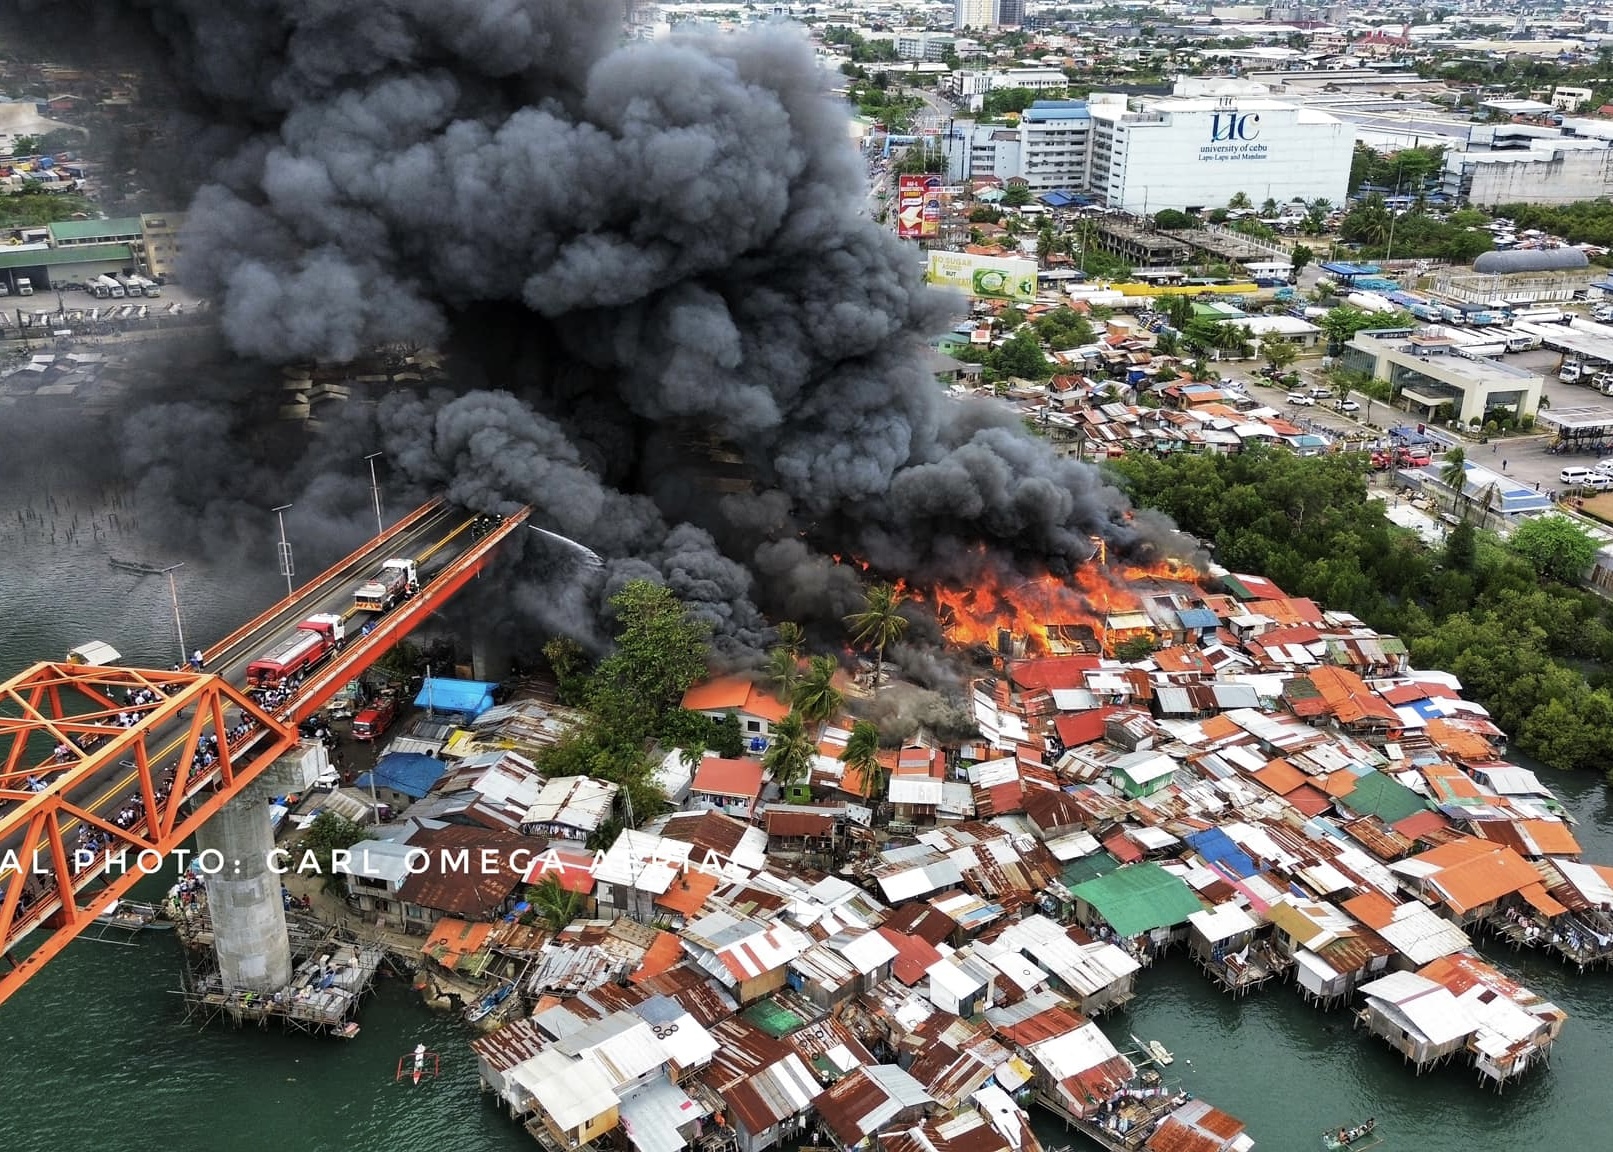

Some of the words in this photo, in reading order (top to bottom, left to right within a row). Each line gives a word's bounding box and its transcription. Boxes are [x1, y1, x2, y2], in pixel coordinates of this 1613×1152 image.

[1210, 112, 1260, 143] UC
[1200, 144, 1238, 154] university
[1240, 144, 1249, 152] of
[1249, 143, 1268, 152] cebu
